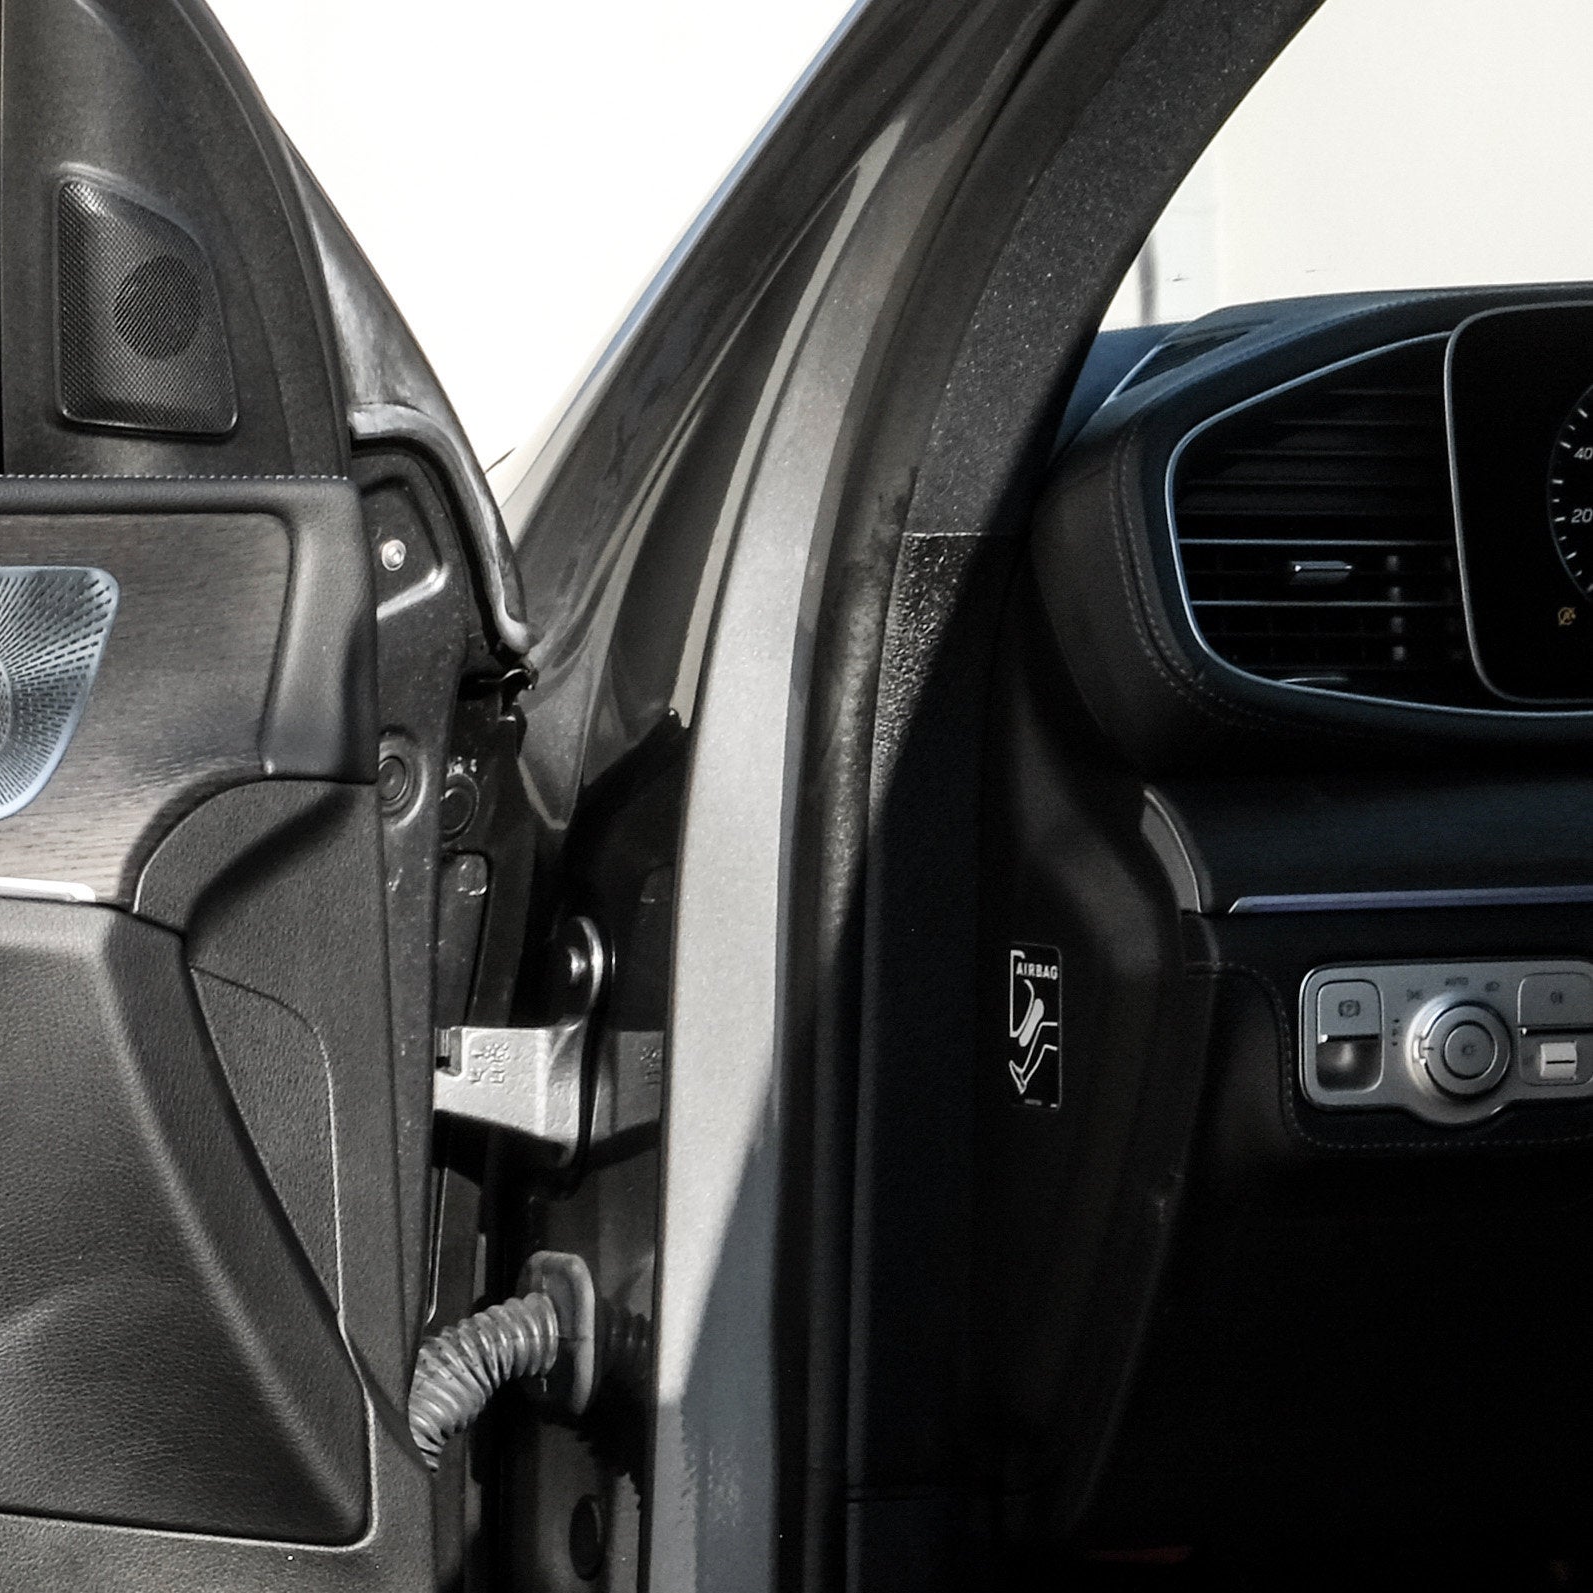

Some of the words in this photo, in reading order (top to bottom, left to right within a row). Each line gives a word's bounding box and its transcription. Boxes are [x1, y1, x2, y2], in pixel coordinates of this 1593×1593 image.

[1573, 447, 1593, 460] 40
[1571, 508, 1593, 523] 20
[1015, 962, 1059, 981] AIRBAG
